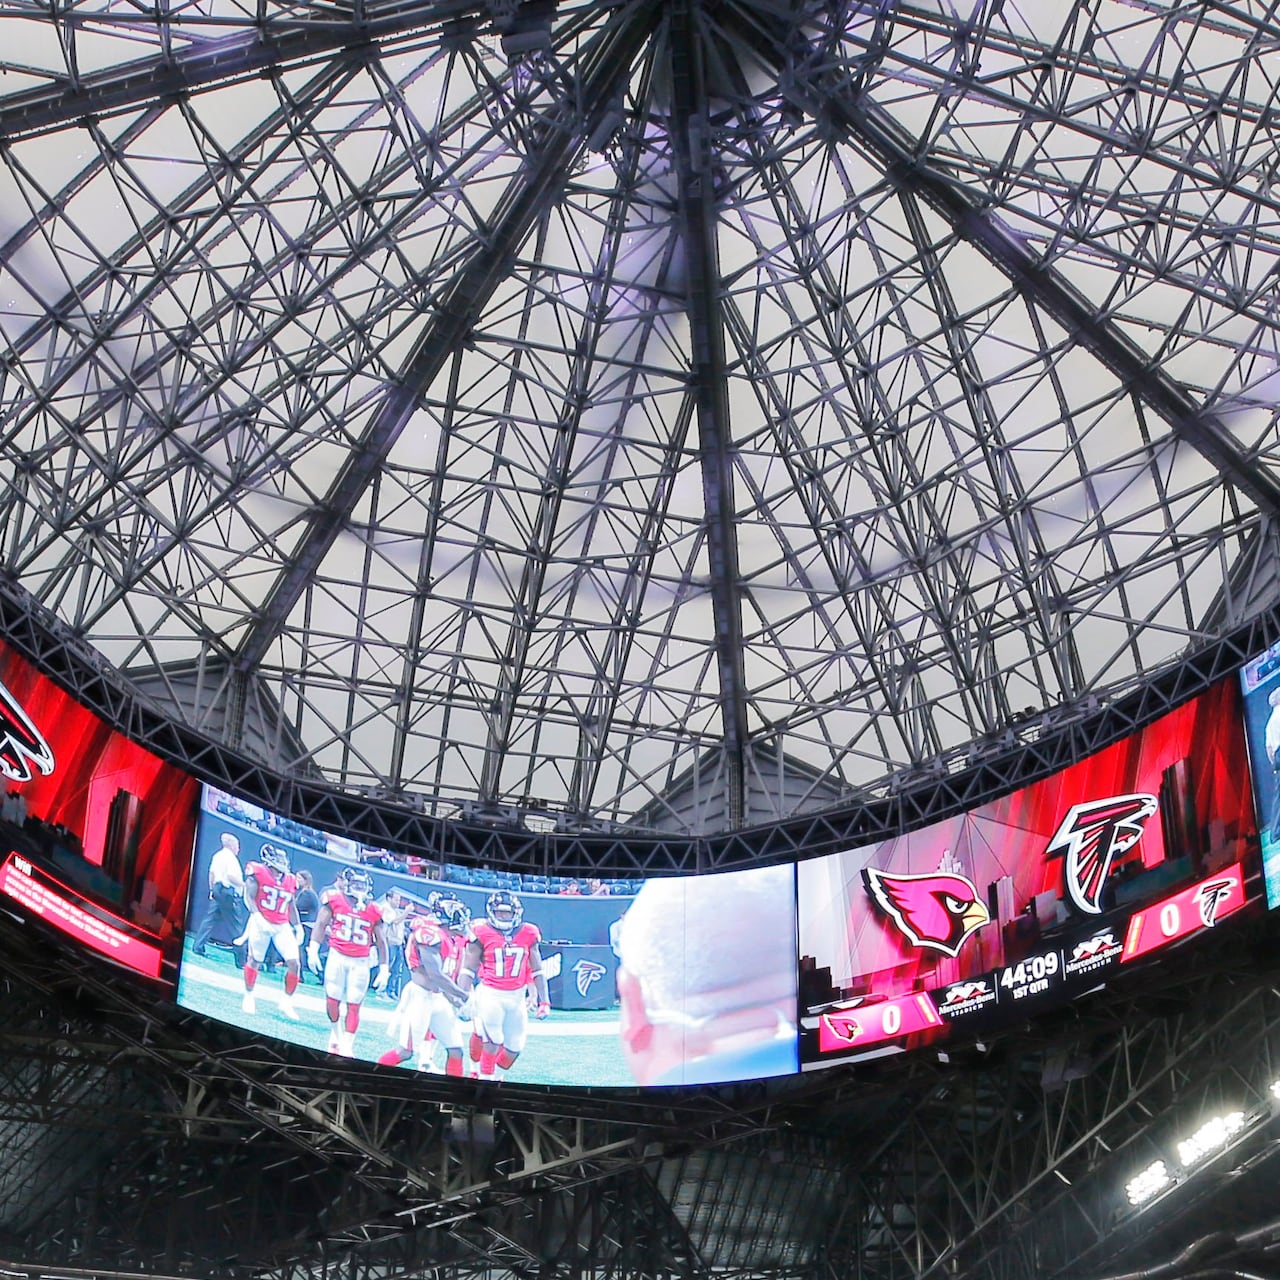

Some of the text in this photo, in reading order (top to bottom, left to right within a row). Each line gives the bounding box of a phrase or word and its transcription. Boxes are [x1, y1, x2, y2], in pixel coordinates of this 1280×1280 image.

[261, 885, 293, 910] 37
[335, 914, 371, 945] 35
[1160, 903, 1180, 937] 0
[493, 947, 525, 977] 17
[1000, 952, 1059, 988] 44:09
[1065, 945, 1123, 974] Mercedes-Benz
[1078, 957, 1112, 974] STADIUM
[1012, 978, 1049, 1000] 1ST QTR
[939, 993, 995, 1015] Mercedes-Benz
[950, 1004, 984, 1017] STADIUM
[882, 1005, 901, 1035] 0
